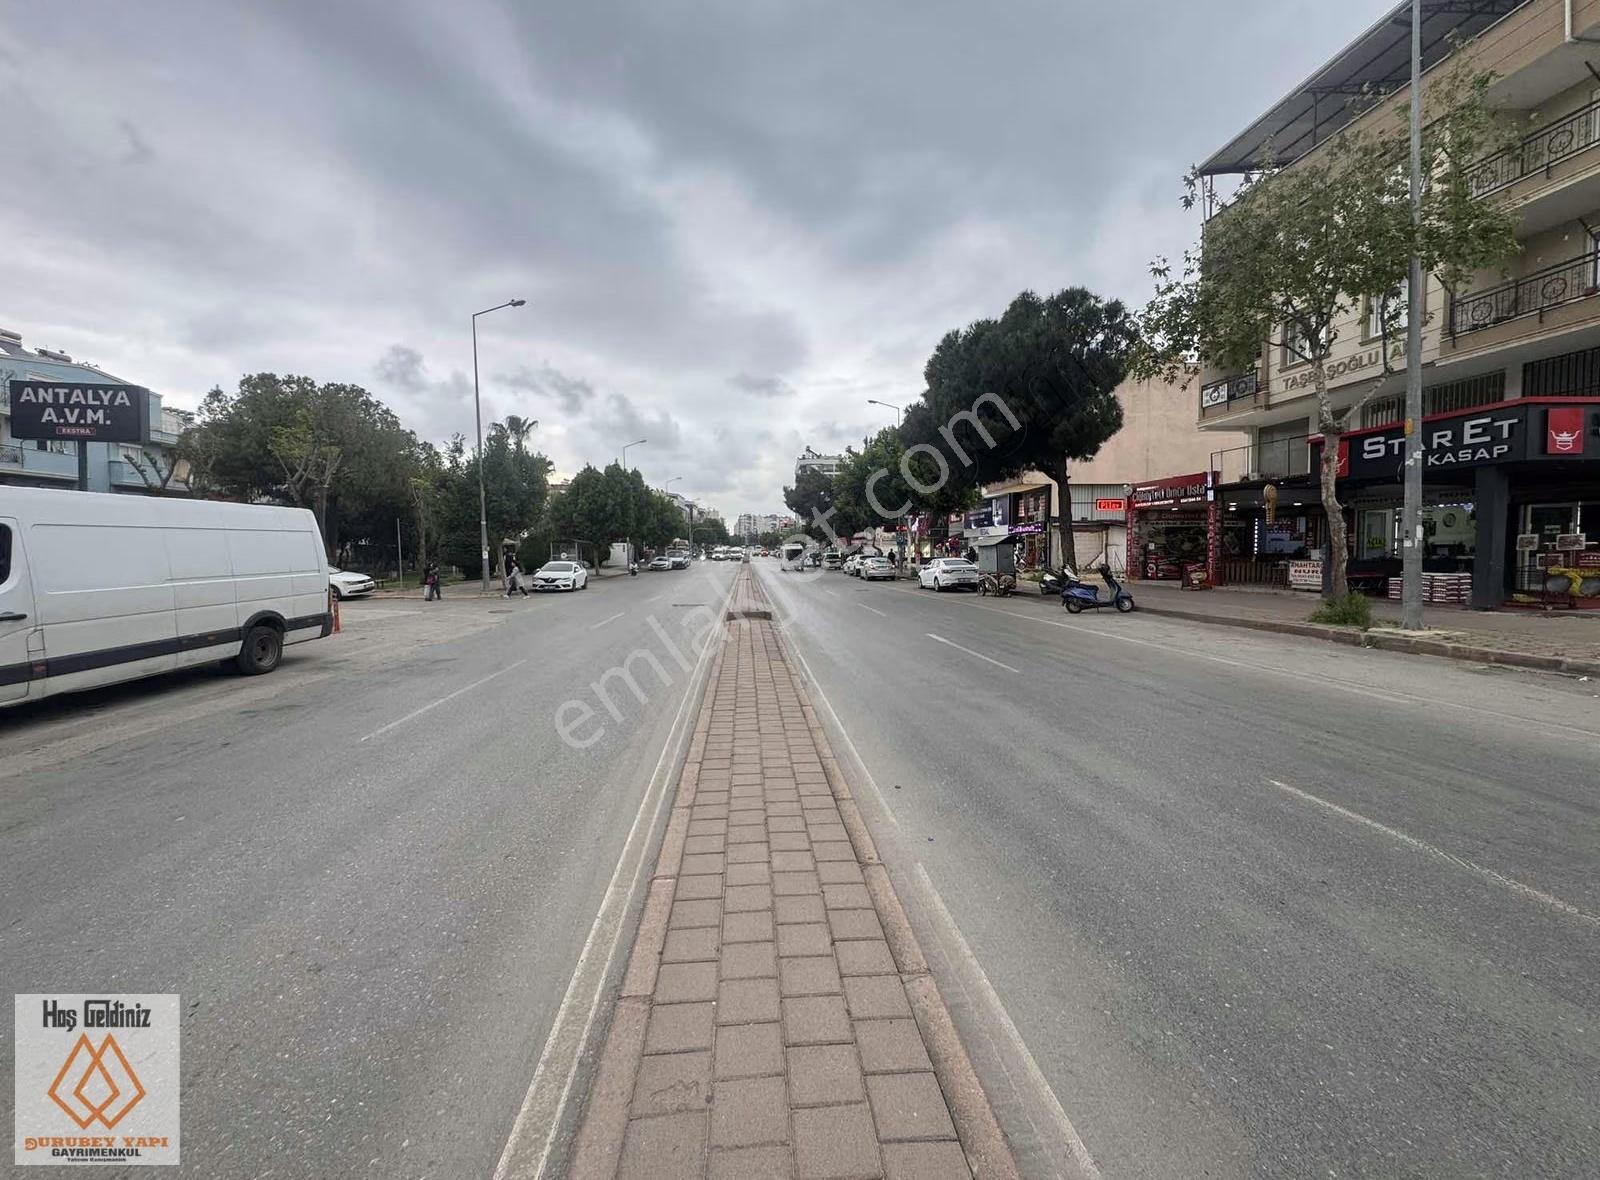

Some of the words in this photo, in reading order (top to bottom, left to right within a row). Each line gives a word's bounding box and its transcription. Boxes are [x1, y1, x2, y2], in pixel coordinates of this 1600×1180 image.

[20, 387, 131, 406] ANTALYA
[41, 407, 112, 425] A.V.M.
[1427, 445, 1509, 466] KASAP
